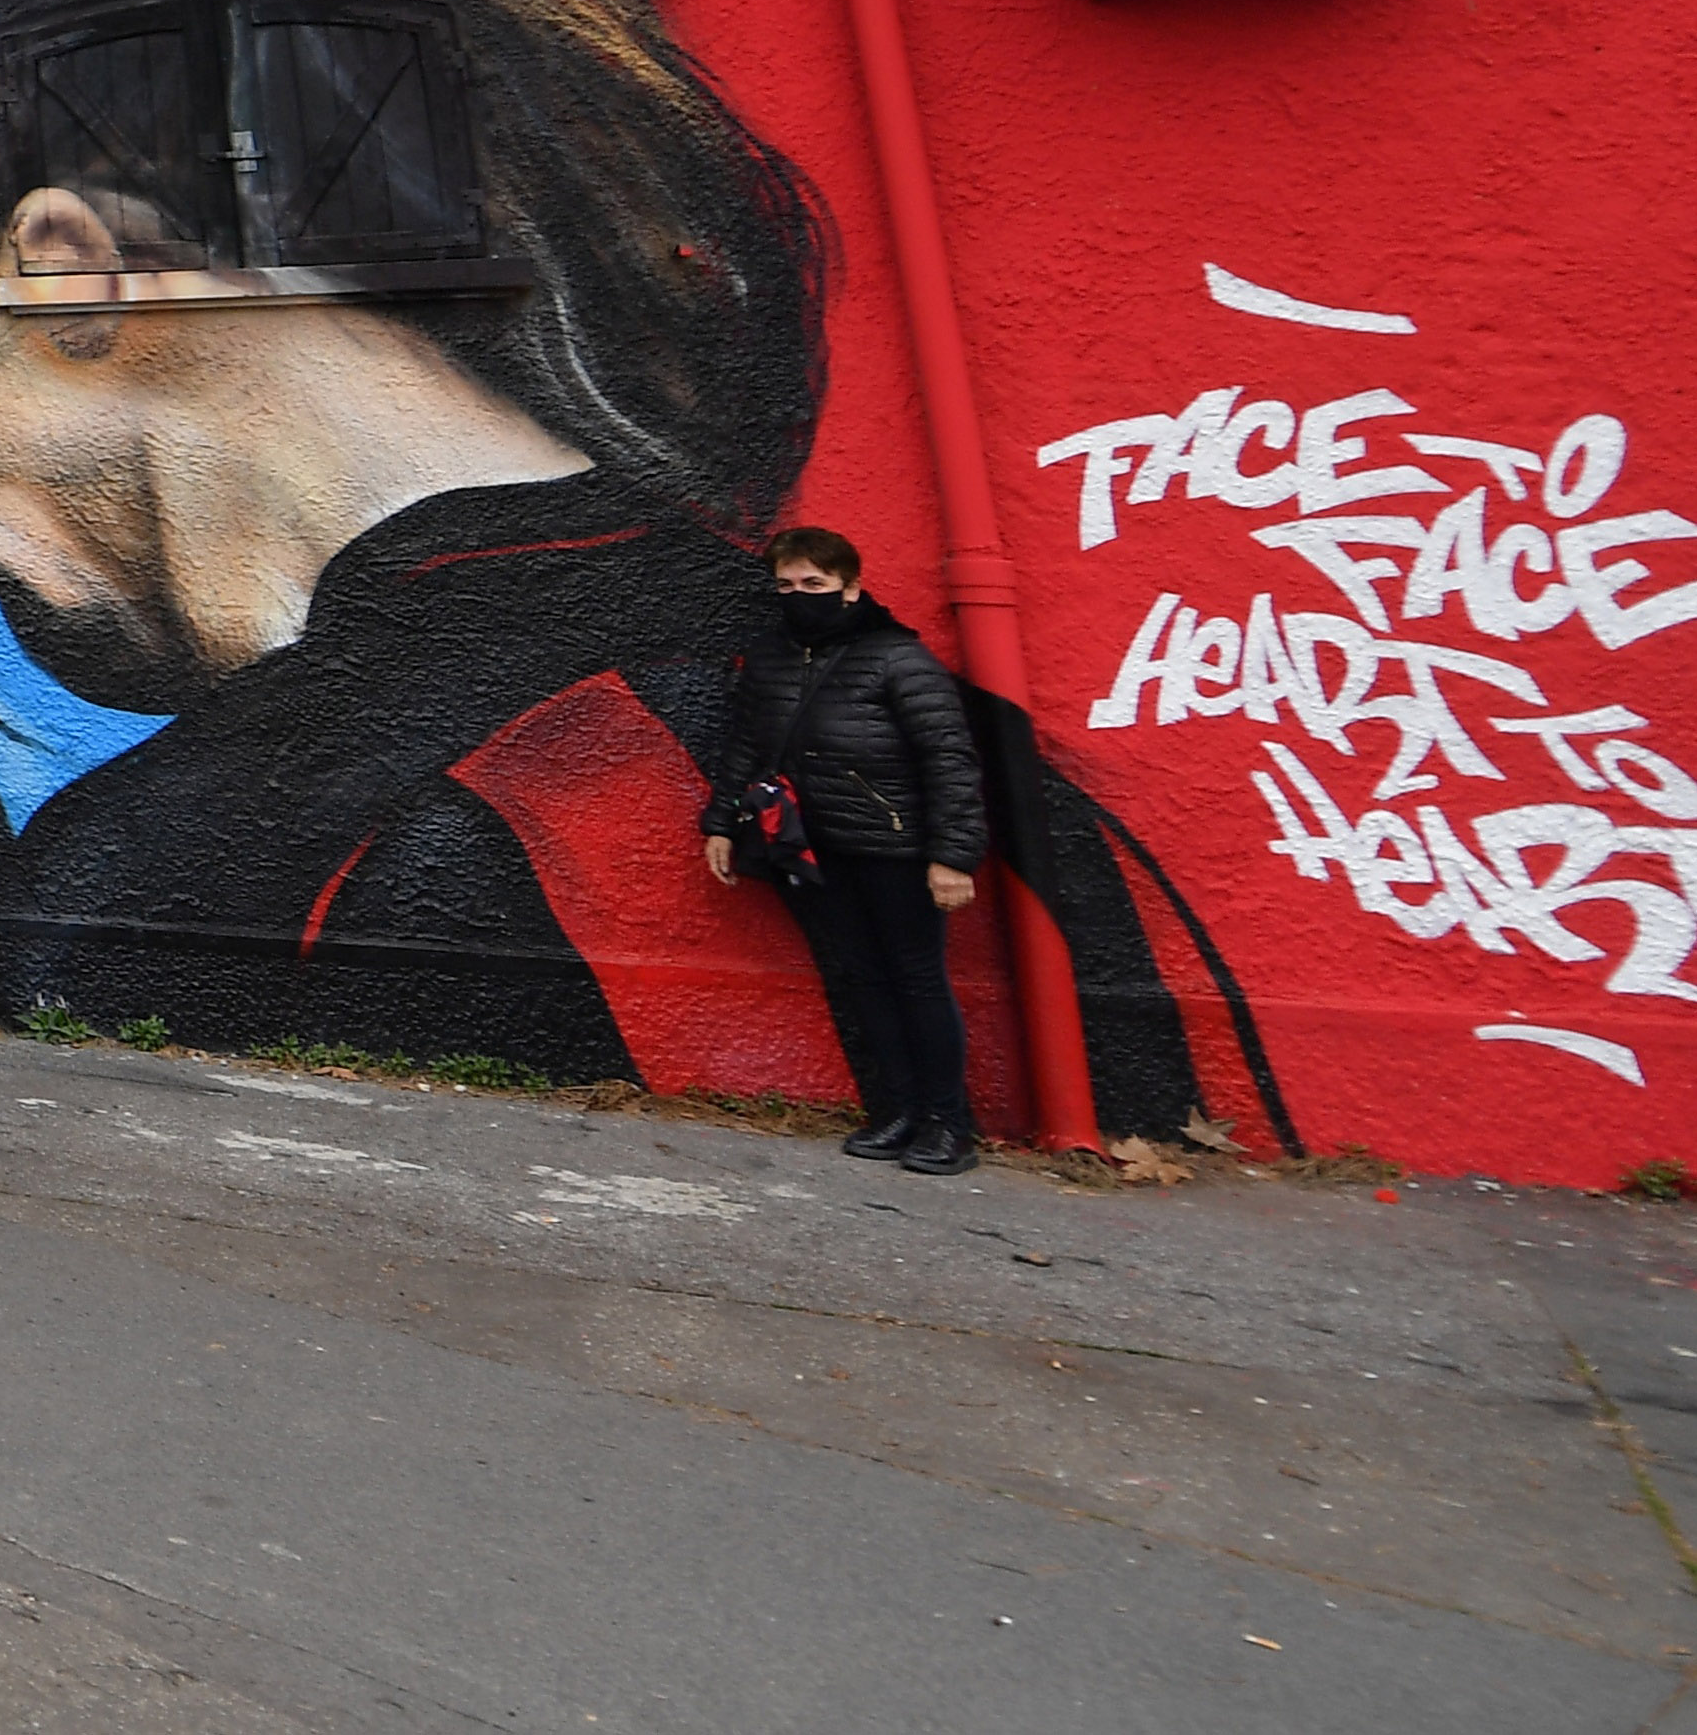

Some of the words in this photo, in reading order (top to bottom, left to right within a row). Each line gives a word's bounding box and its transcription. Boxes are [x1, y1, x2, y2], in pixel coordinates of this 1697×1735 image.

[1037, 385, 1452, 551] FACE
[1401, 413, 1627, 519] TO
[1250, 486, 1697, 651] FACE
